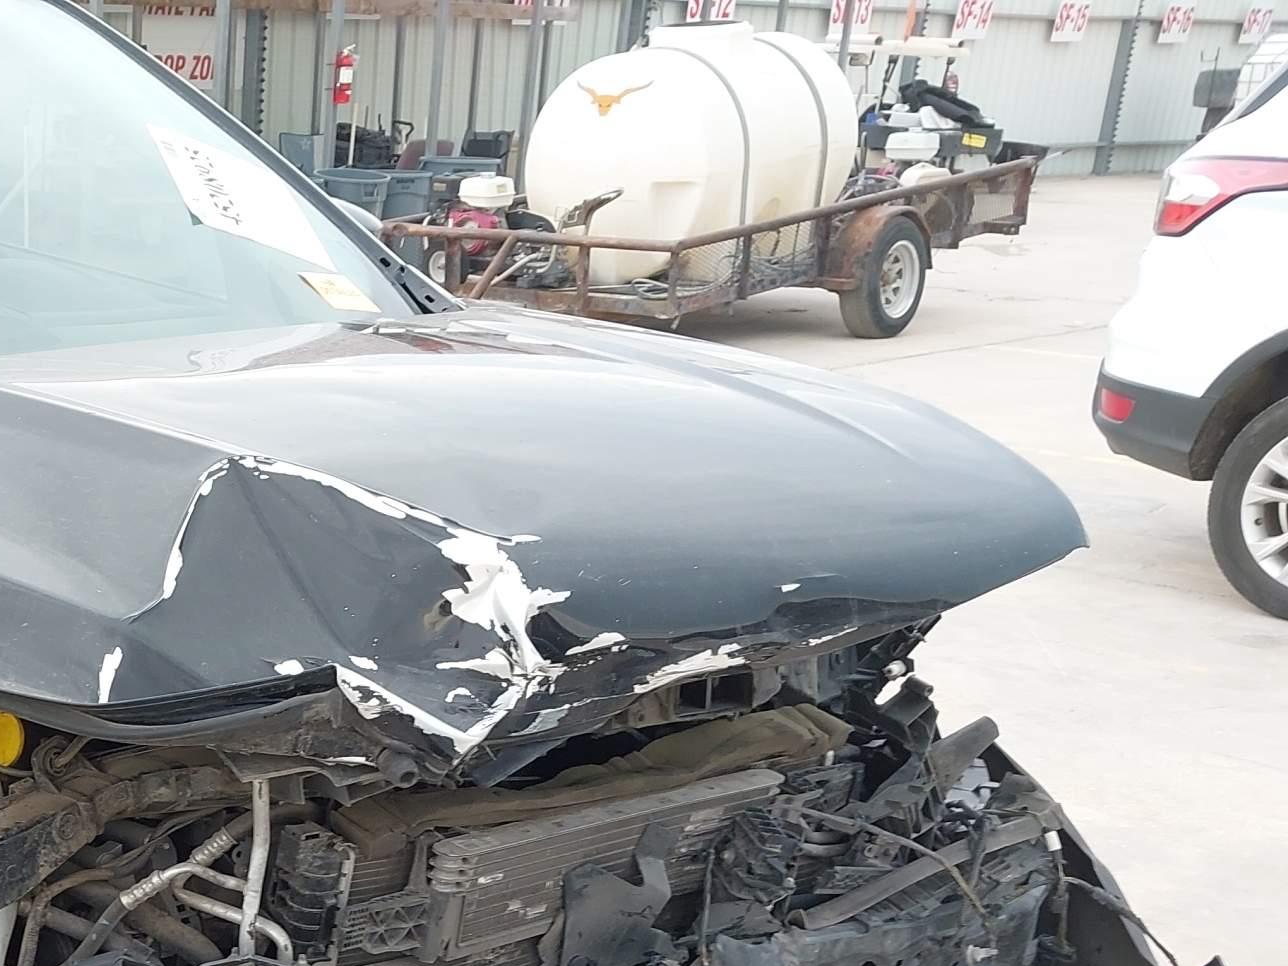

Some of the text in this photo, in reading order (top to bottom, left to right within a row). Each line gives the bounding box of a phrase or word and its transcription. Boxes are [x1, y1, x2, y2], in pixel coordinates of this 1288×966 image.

[956, 0, 994, 30] SF-14
[1055, 4, 1090, 32] SF-15
[189, 54, 214, 80] ZO
